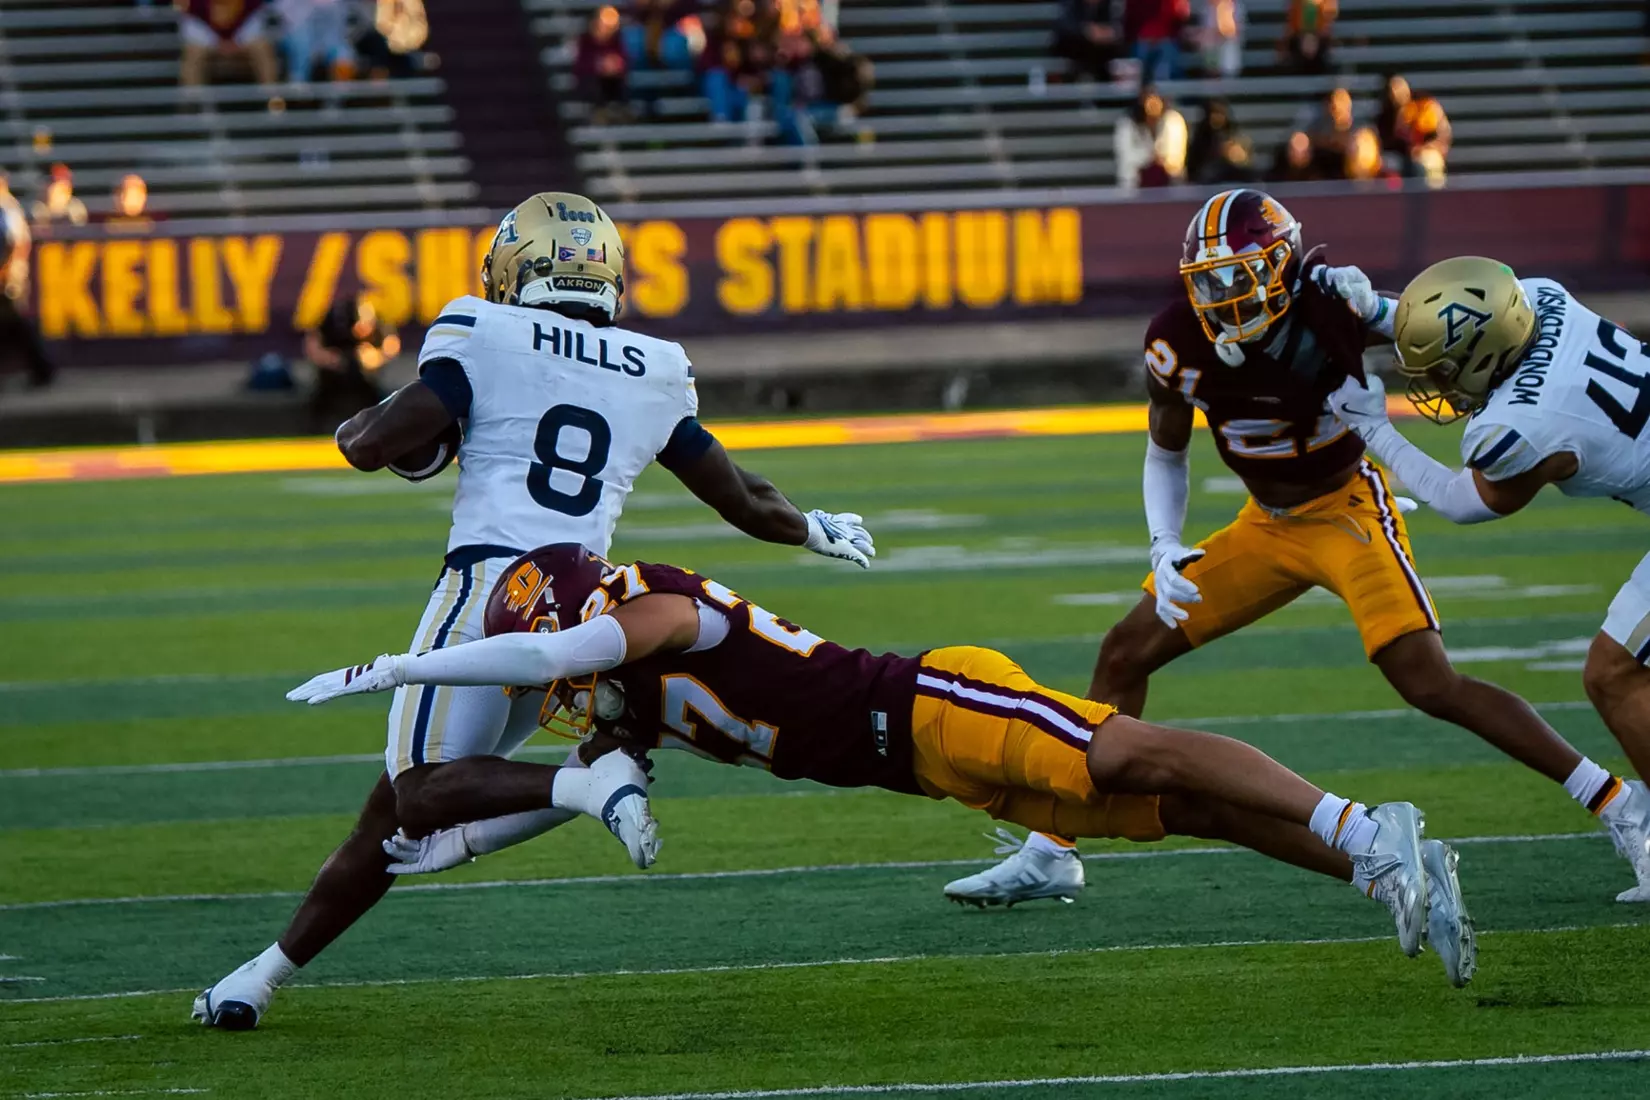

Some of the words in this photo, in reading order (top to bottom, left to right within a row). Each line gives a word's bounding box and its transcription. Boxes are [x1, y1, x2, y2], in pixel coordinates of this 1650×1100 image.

[38, 220, 689, 338] KELLY/SHS
[715, 208, 1083, 315] STADIUM
[556, 279, 602, 290] AKRON
[532, 322, 647, 377] HILLS
[1437, 302, 1493, 351] A
[1143, 337, 1211, 411] 21
[526, 403, 612, 518] 8
[578, 563, 651, 624] 27
[658, 672, 781, 771] 7
